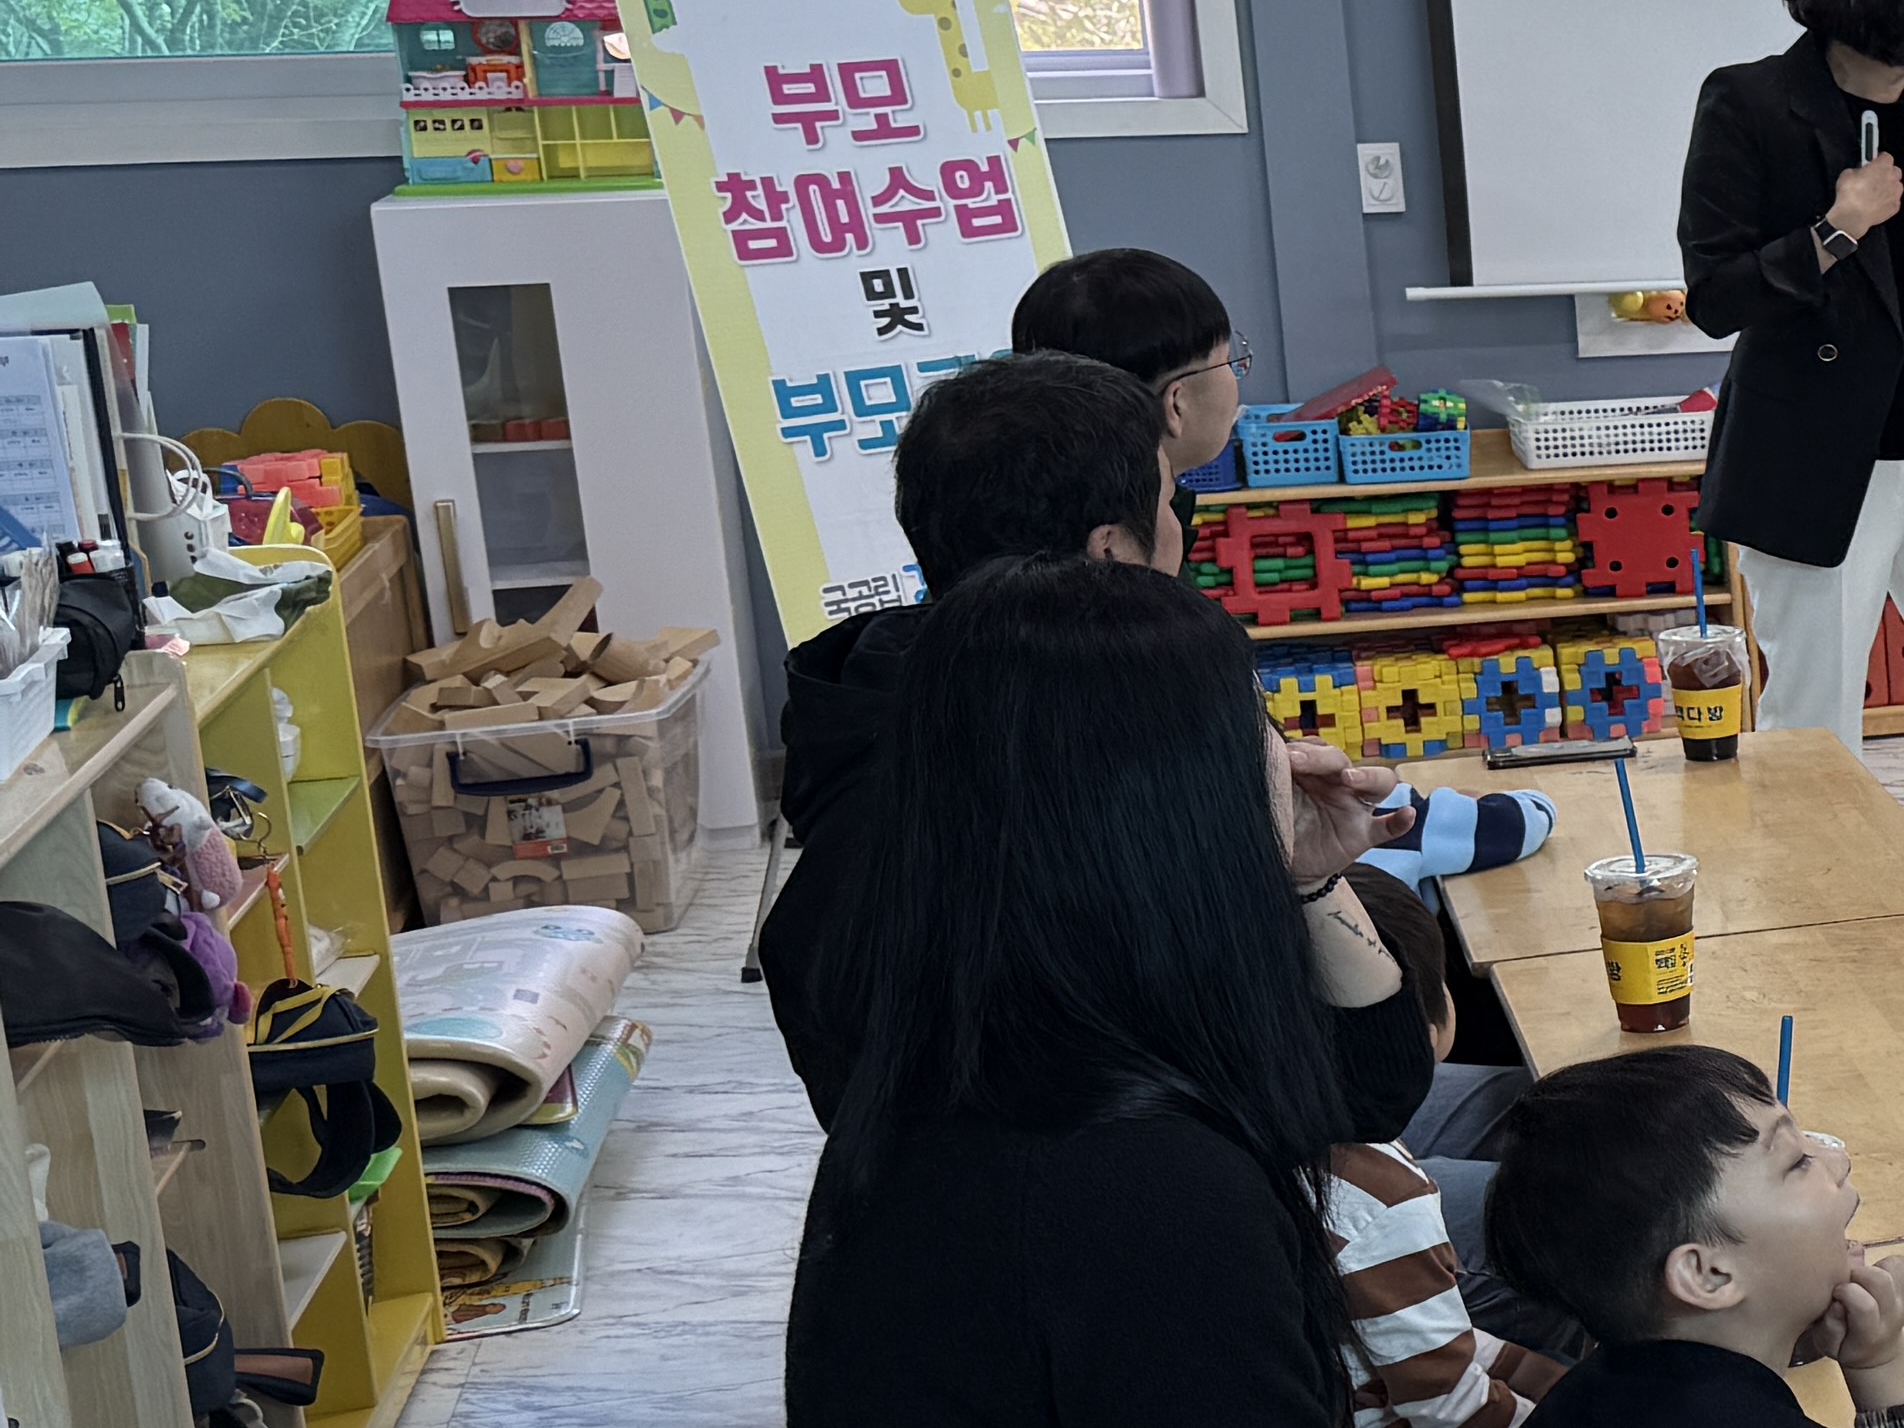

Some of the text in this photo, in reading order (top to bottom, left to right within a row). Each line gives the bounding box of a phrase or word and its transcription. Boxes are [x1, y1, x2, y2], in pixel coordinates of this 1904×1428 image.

[763, 58, 924, 148] 부모
[714, 154, 1021, 262] 참여수업
[858, 267, 927, 338] 및
